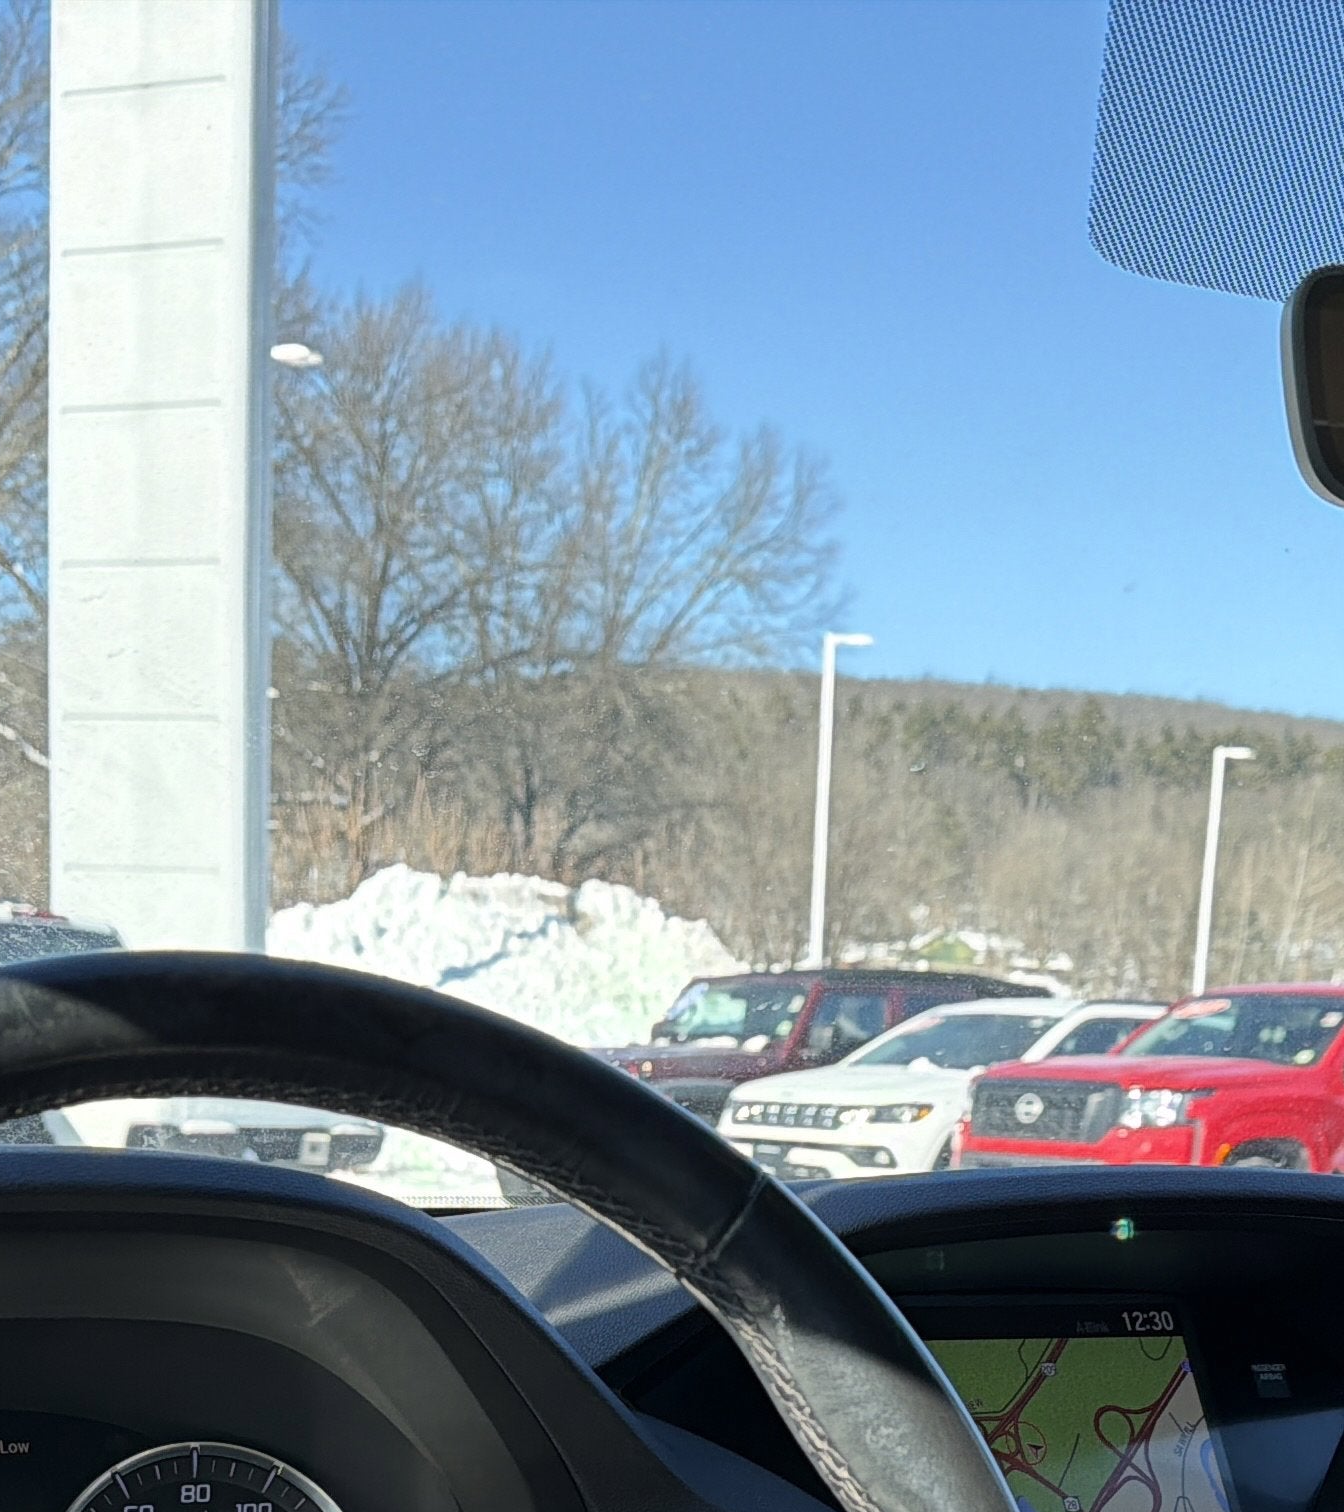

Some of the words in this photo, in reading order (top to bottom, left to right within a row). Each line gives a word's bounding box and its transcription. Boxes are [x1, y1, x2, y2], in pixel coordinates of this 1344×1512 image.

[1121, 1310, 1174, 1332] 12:30
[0, 1439, 31, 1455] Low
[180, 1484, 211, 1503] 80
[1066, 1499, 1078, 1510] 28
